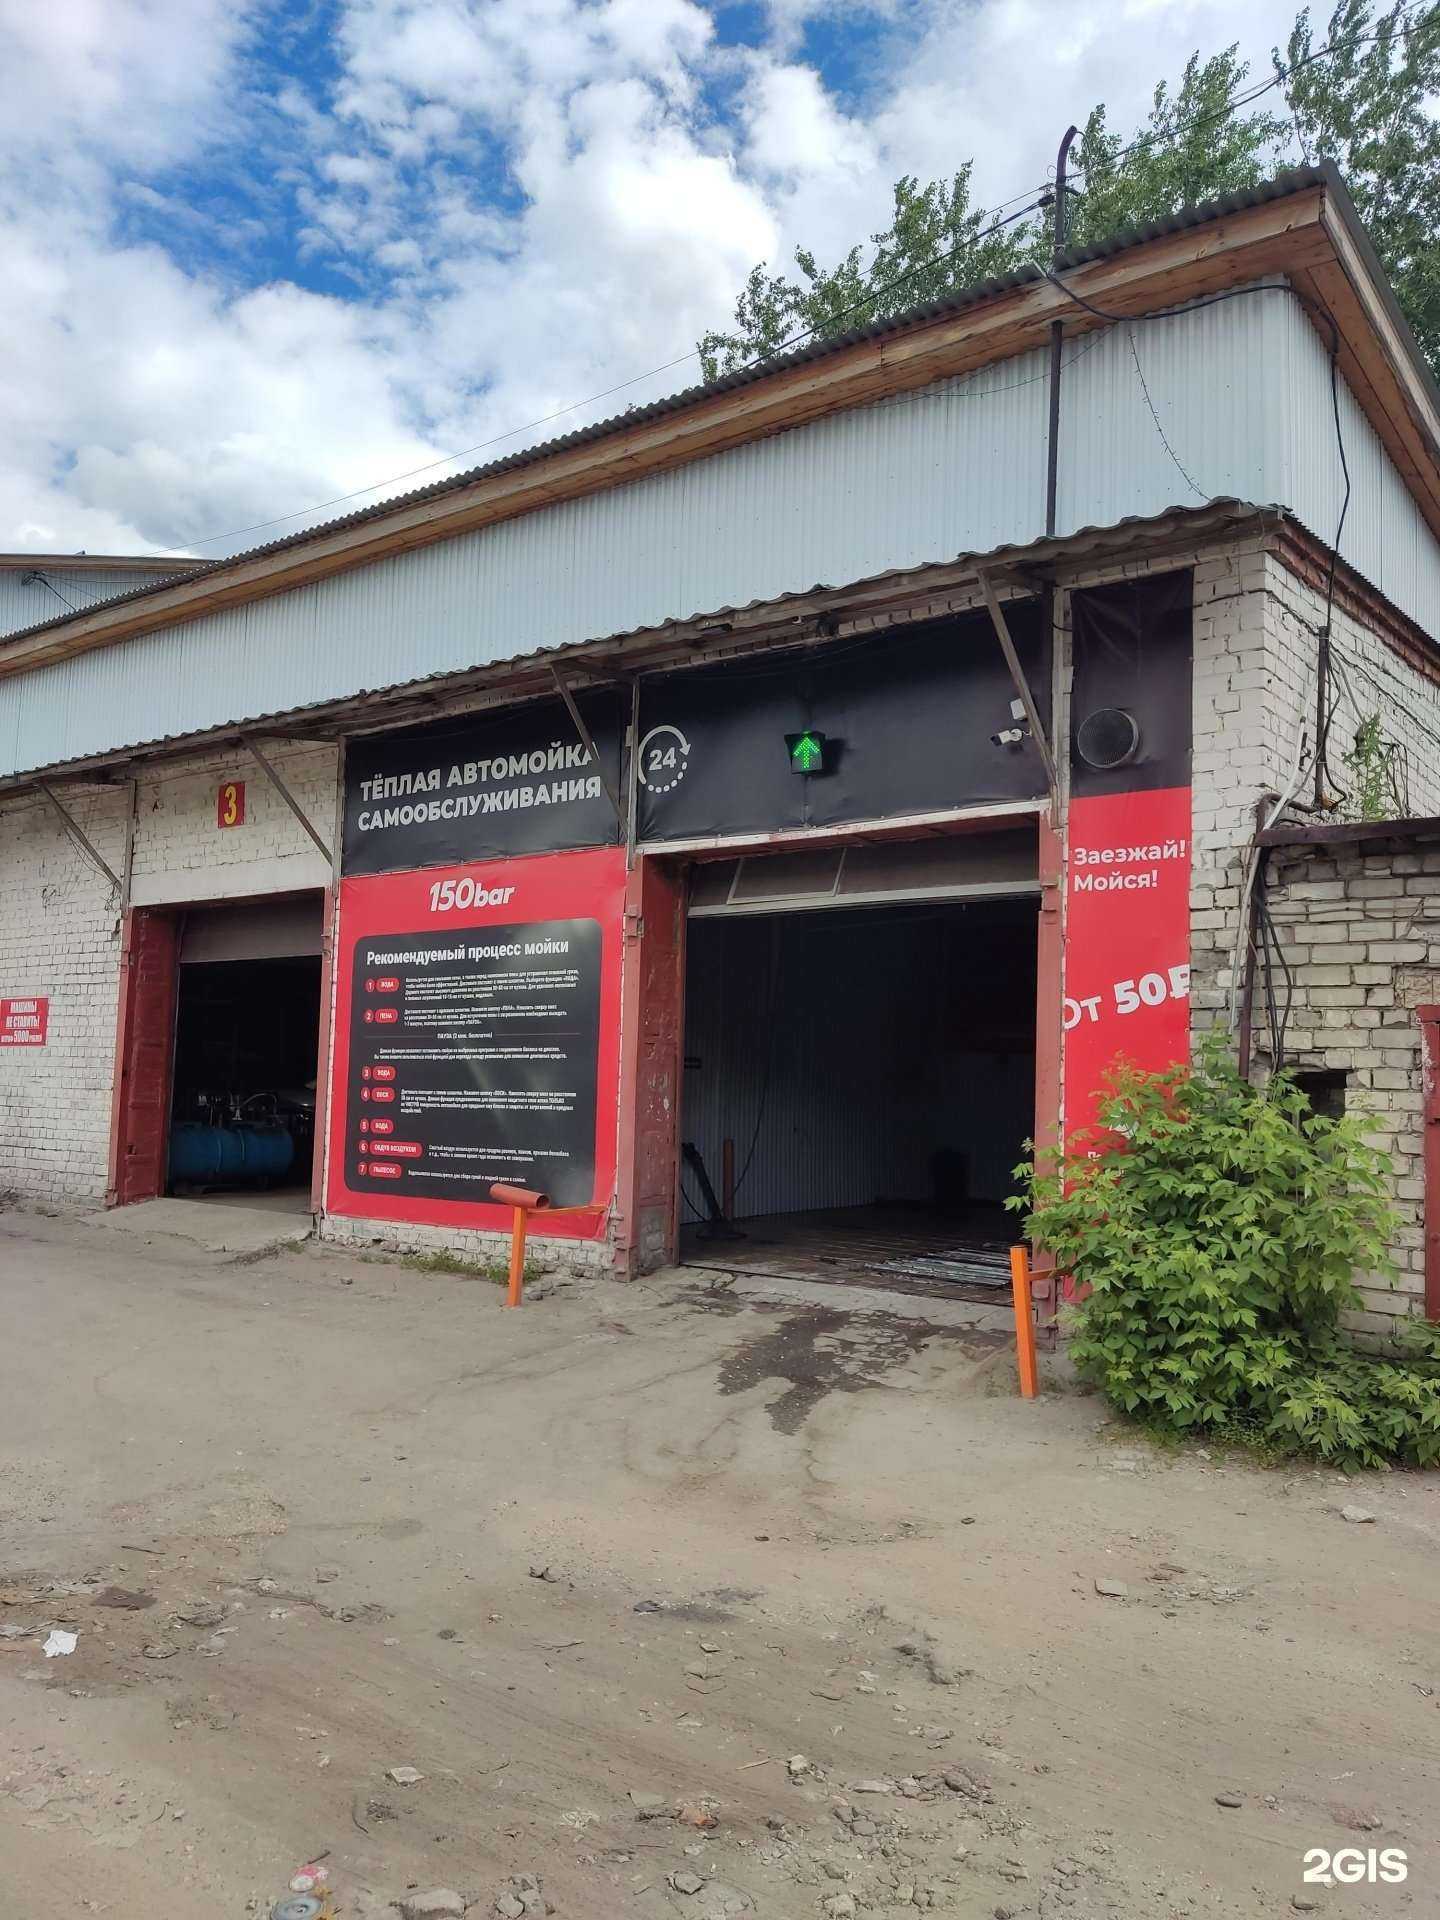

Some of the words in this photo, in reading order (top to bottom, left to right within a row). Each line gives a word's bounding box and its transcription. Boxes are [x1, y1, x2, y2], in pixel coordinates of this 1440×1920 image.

[649, 747, 677, 771] 24
[360, 769, 441, 801] ТЁПЛАЯ
[223, 785, 237, 825] 3
[358, 776, 601, 831] САМООБСЛУЖИВАНИЯ
[1074, 839, 1186, 866] Заезжай!
[429, 877, 516, 912] 150bar
[1074, 869, 1158, 892] Мойся!
[366, 944, 465, 966] Рекомендуемый
[468, 944, 521, 962] процесс
[524, 938, 569, 955] мойки
